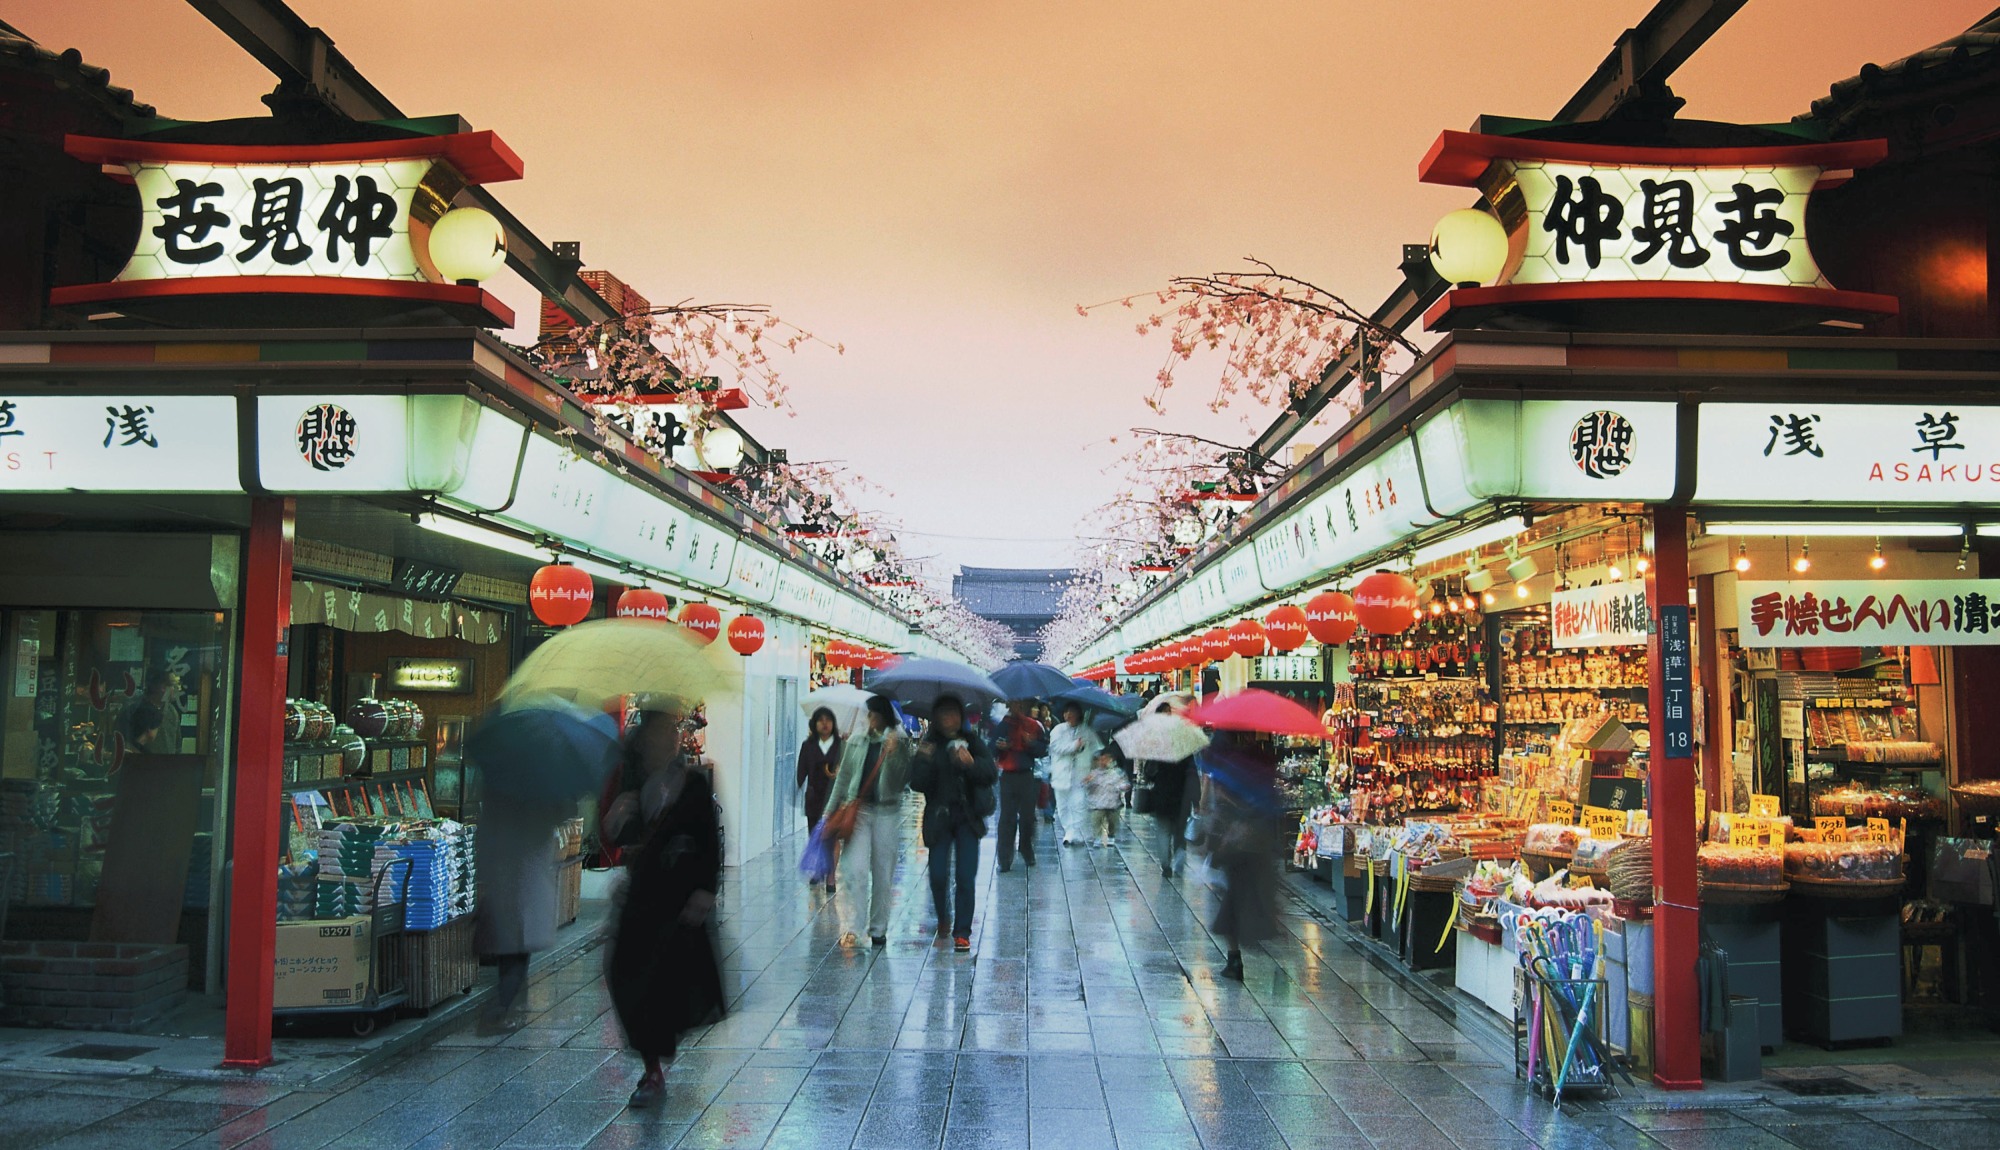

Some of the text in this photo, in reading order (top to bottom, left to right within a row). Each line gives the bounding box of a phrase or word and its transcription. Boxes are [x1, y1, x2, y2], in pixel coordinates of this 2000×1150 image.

[1542, 174, 1796, 272] 仲見世
[1669, 639, 1683, 719] 浅草一丁目
[1668, 732, 1688, 748] 18
[1594, 826, 1613, 836] ¥130
[1734, 835, 1753, 847] ¥84
[1821, 834, 1842, 843] ¥90
[320, 928, 350, 936] 13297
